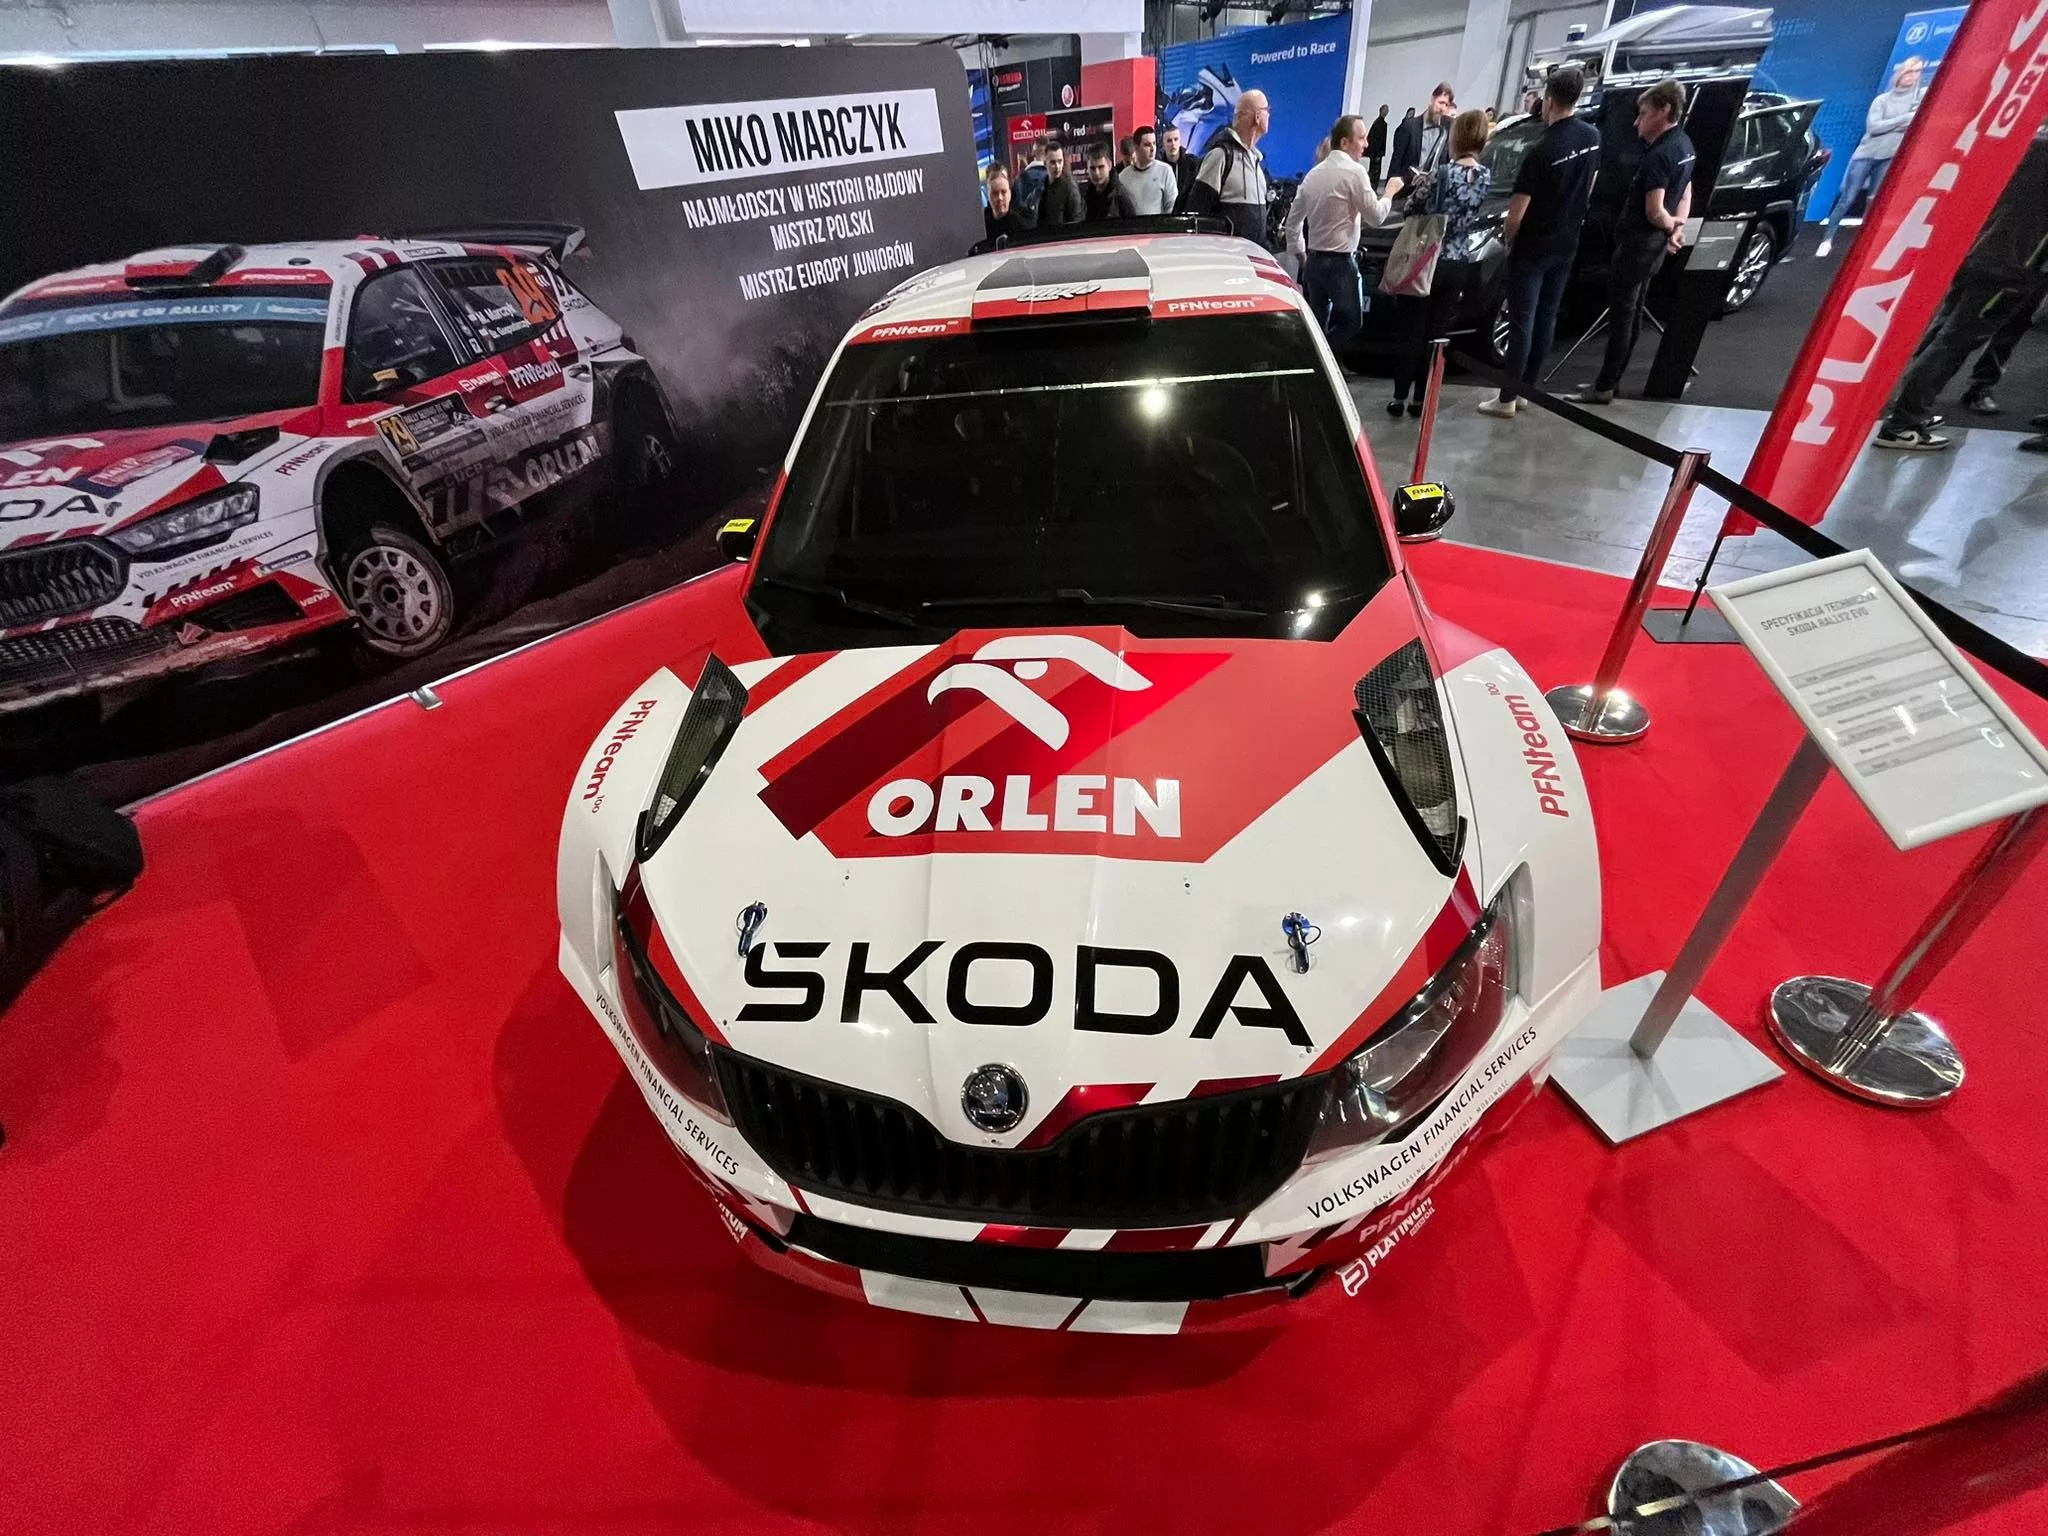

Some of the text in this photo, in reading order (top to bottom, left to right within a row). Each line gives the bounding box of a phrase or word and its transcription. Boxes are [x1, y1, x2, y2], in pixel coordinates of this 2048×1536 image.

[1251, 42, 1336, 65] Powered to Race
[685, 102, 907, 173] MIKO MARCZYK
[682, 168, 924, 229] NAJMŁODSZY W HISTORII RAJDOWY
[770, 209, 874, 251] MISTRZ POLSKI
[739, 266, 797, 301] MISTRZ
[796, 254, 851, 289] EUROPY
[852, 241, 915, 277] JUNIORÓW
[872, 324, 947, 338] PFNteam
[1168, 299, 1256, 312] PFNteam
[508, 359, 562, 389] PFNteam
[525, 435, 602, 489] ORLEN
[170, 580, 235, 608] PFNteam
[583, 700, 658, 800] PFNteam
[1504, 695, 1569, 818] PFNteam
[867, 774, 1183, 838] ORLEN
[595, 994, 641, 1067] VOLKSWAGEN
[640, 1059, 684, 1125] FINANCIAL
[684, 1119, 740, 1176] SERVICES
[1307, 1026, 1538, 1219] VOLKSWAGEN FINANCIAL SERVICES
[1364, 1196, 1433, 1268] PLATINUM
[1424, 1207, 1436, 1220] OIL
